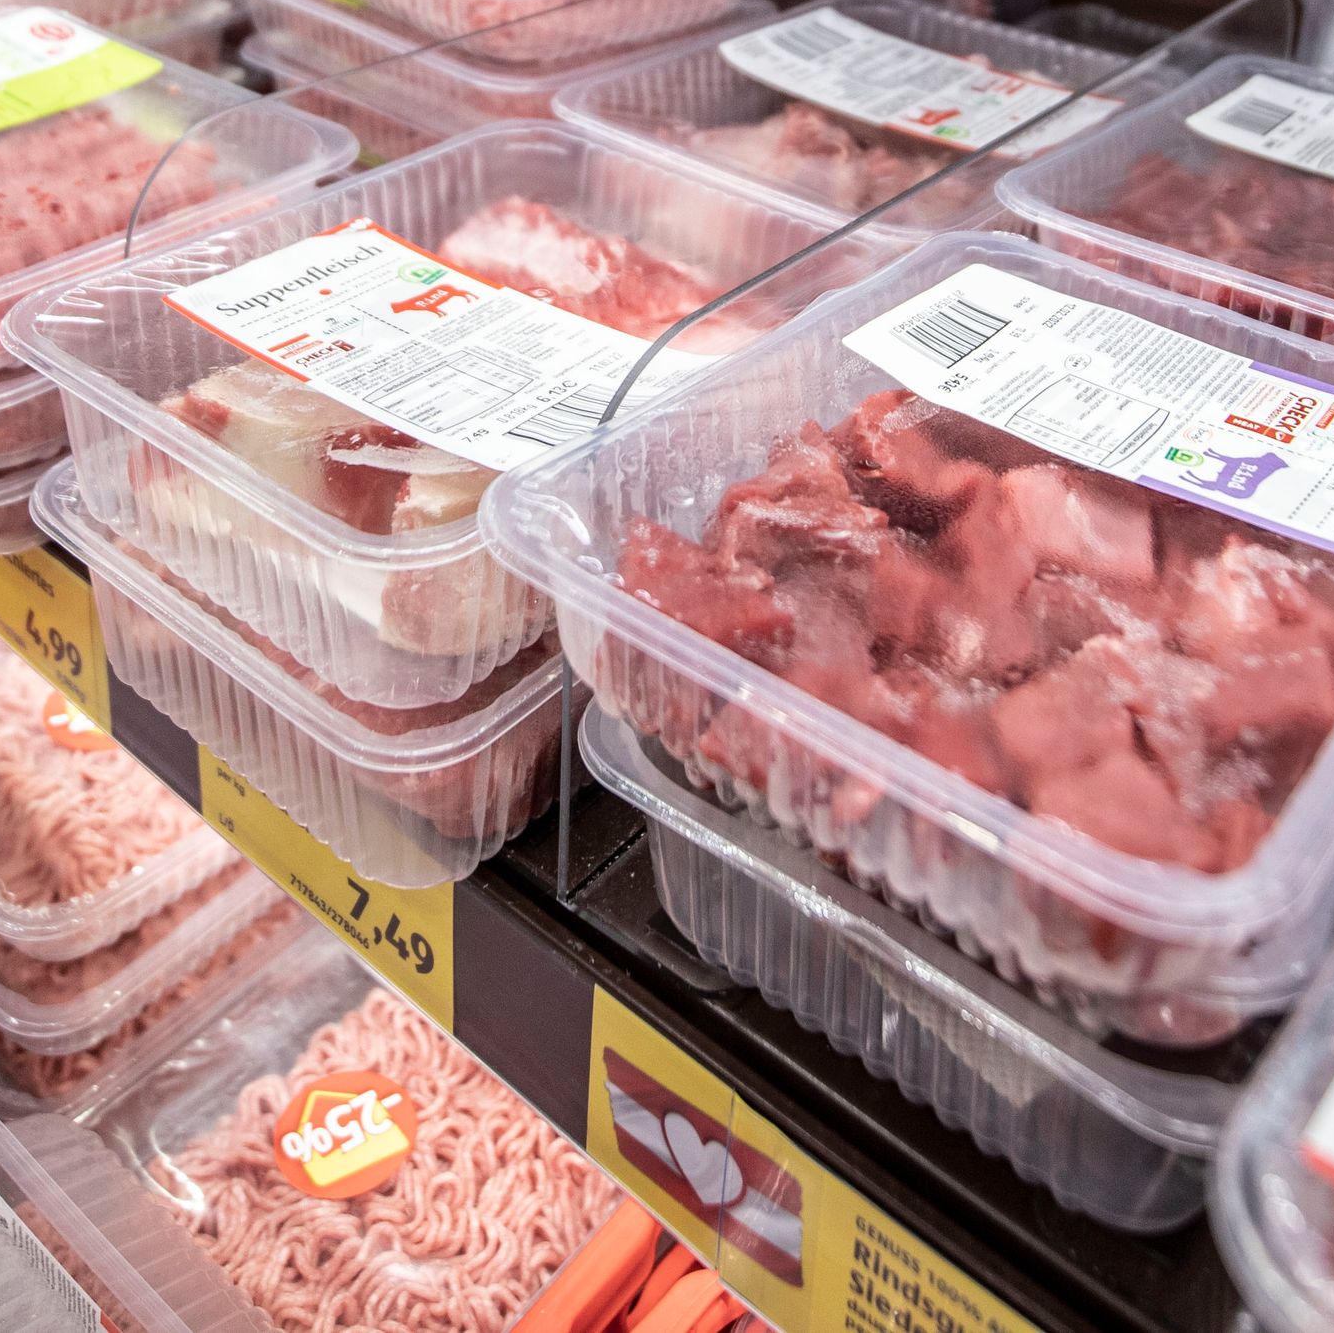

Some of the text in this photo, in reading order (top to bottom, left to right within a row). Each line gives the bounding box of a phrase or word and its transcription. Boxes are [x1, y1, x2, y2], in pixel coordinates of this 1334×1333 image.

[216, 243, 384, 317] Suppenfleisch
[415, 288, 450, 309] Rind
[295, 345, 336, 366] CHECK
[1277, 396, 1318, 438] CHECK
[1227, 461, 1259, 491] Rind
[25, 606, 83, 677] 4,99
[289, 873, 370, 950] 717843/278046
[346, 876, 435, 975] 7,49
[280, 1088, 404, 1164] -25%
[855, 1215, 921, 1275] GENUSS
[927, 1268, 982, 1322] 100%
